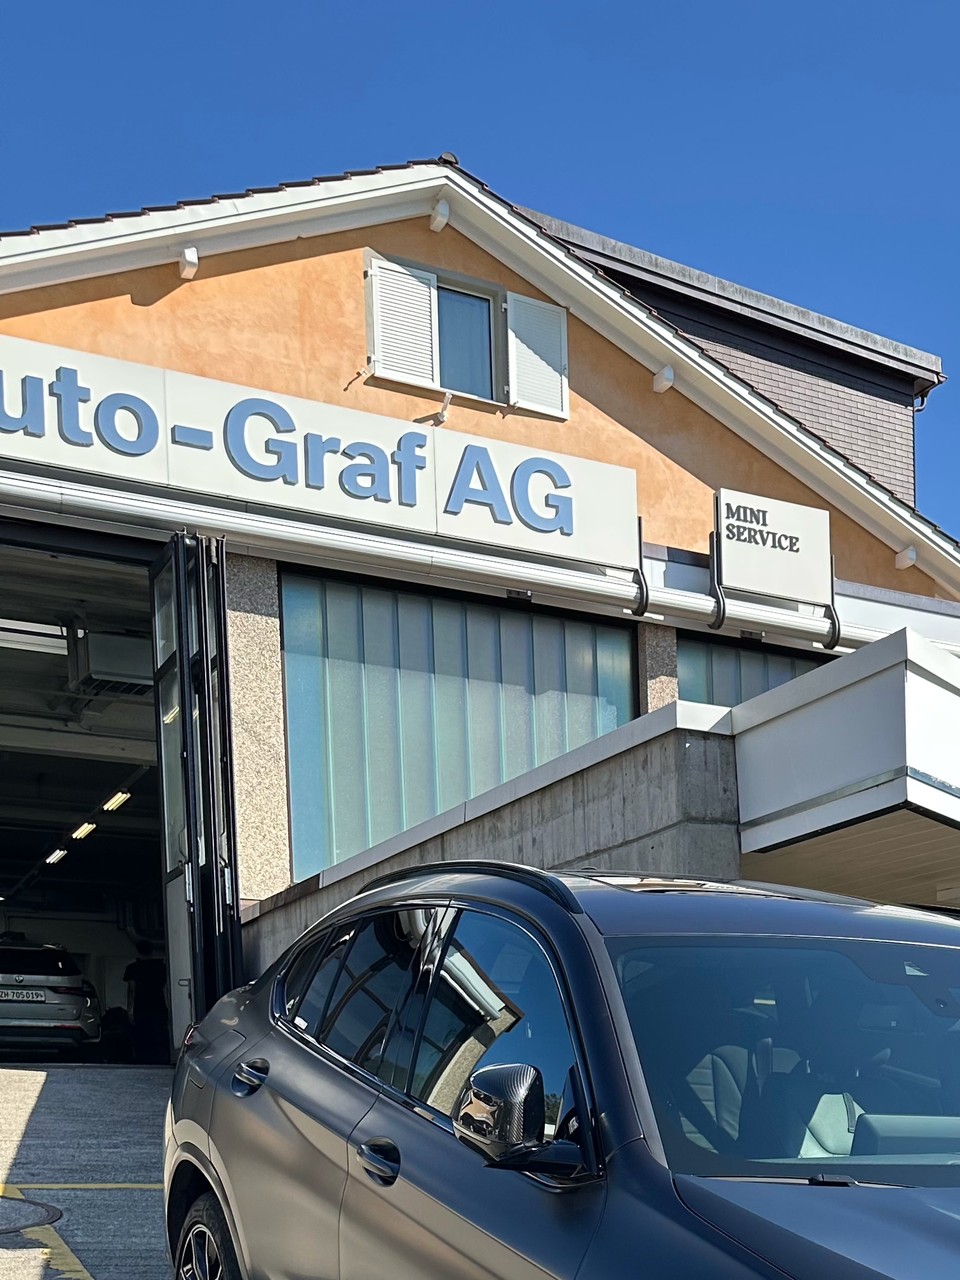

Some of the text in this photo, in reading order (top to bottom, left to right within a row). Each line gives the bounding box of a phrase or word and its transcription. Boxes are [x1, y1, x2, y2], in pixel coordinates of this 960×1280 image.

[443, 442, 574, 537] AG
[725, 502, 768, 527] MINI
[725, 523, 800, 553] SERVICE
